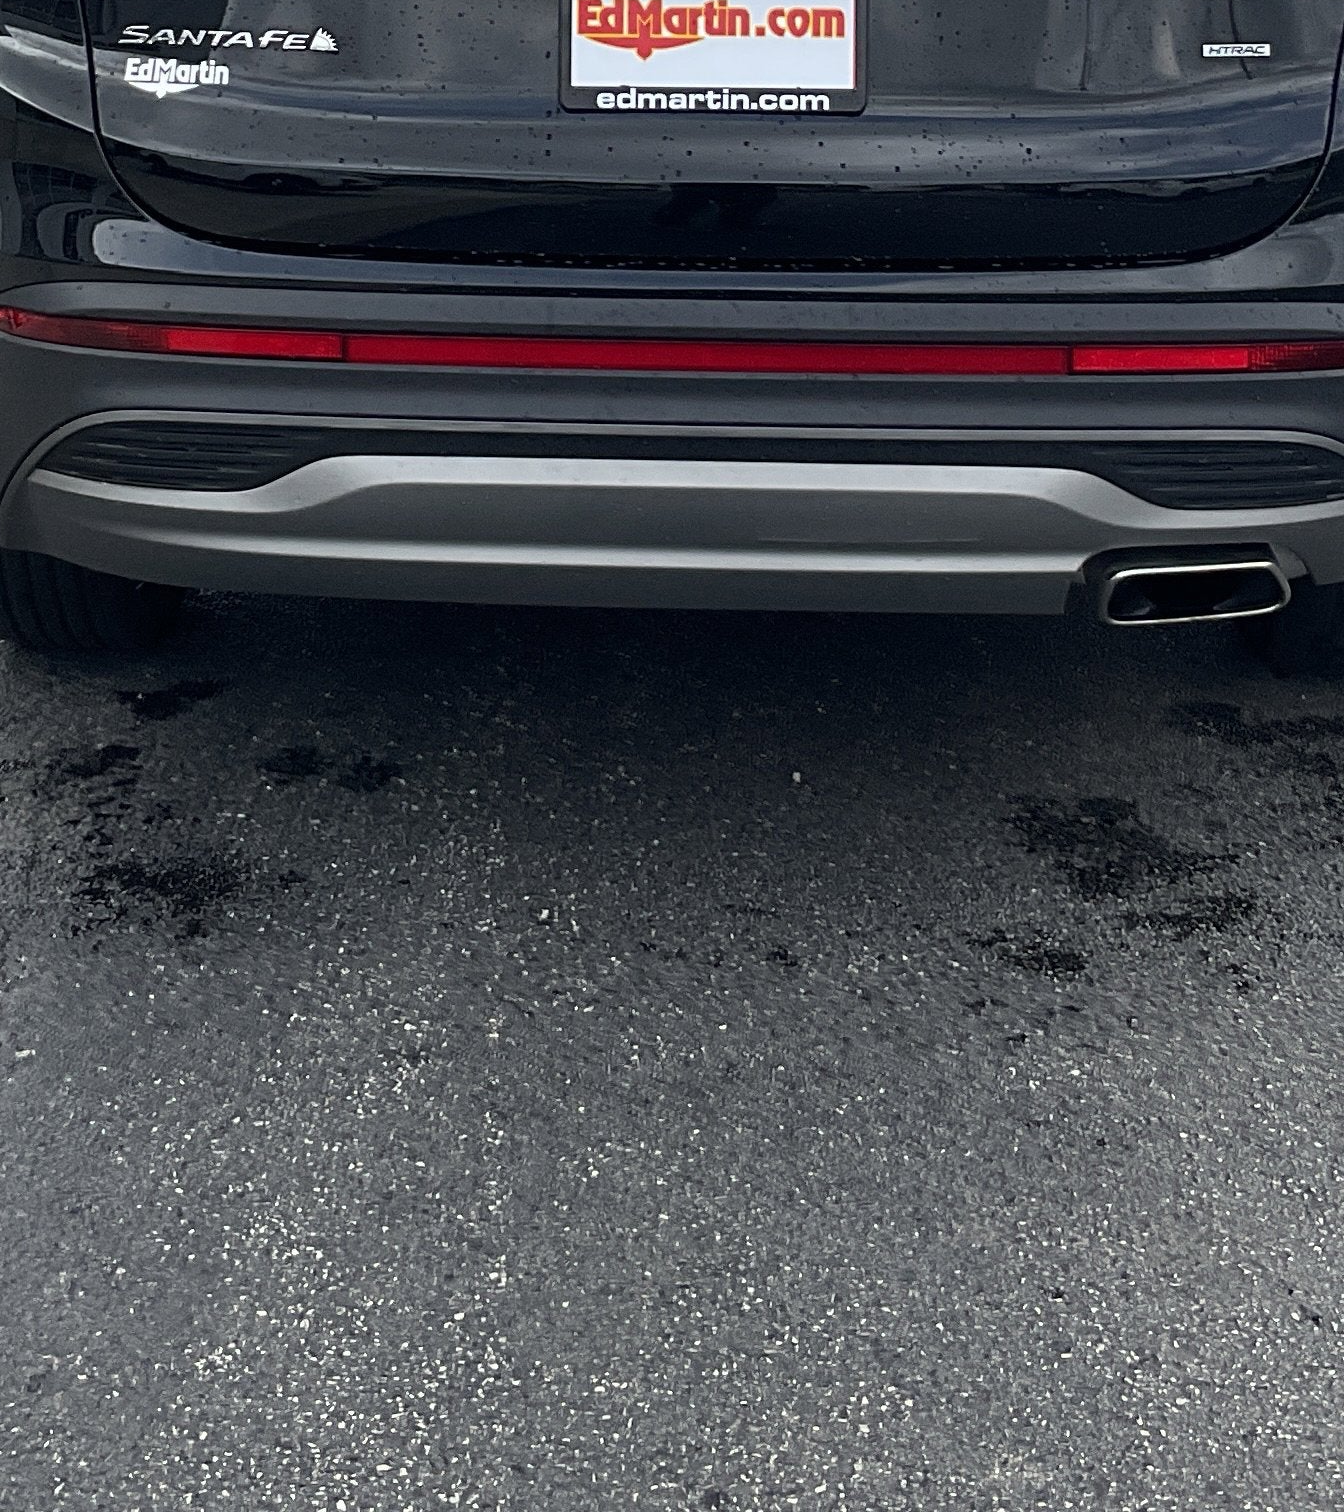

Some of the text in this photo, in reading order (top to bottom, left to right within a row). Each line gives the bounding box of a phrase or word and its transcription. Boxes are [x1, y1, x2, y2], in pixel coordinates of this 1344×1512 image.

[1208, 45, 1266, 55] HTRAC
[123, 57, 231, 86] EdMartin
[596, 88, 831, 111] edmartin.com
